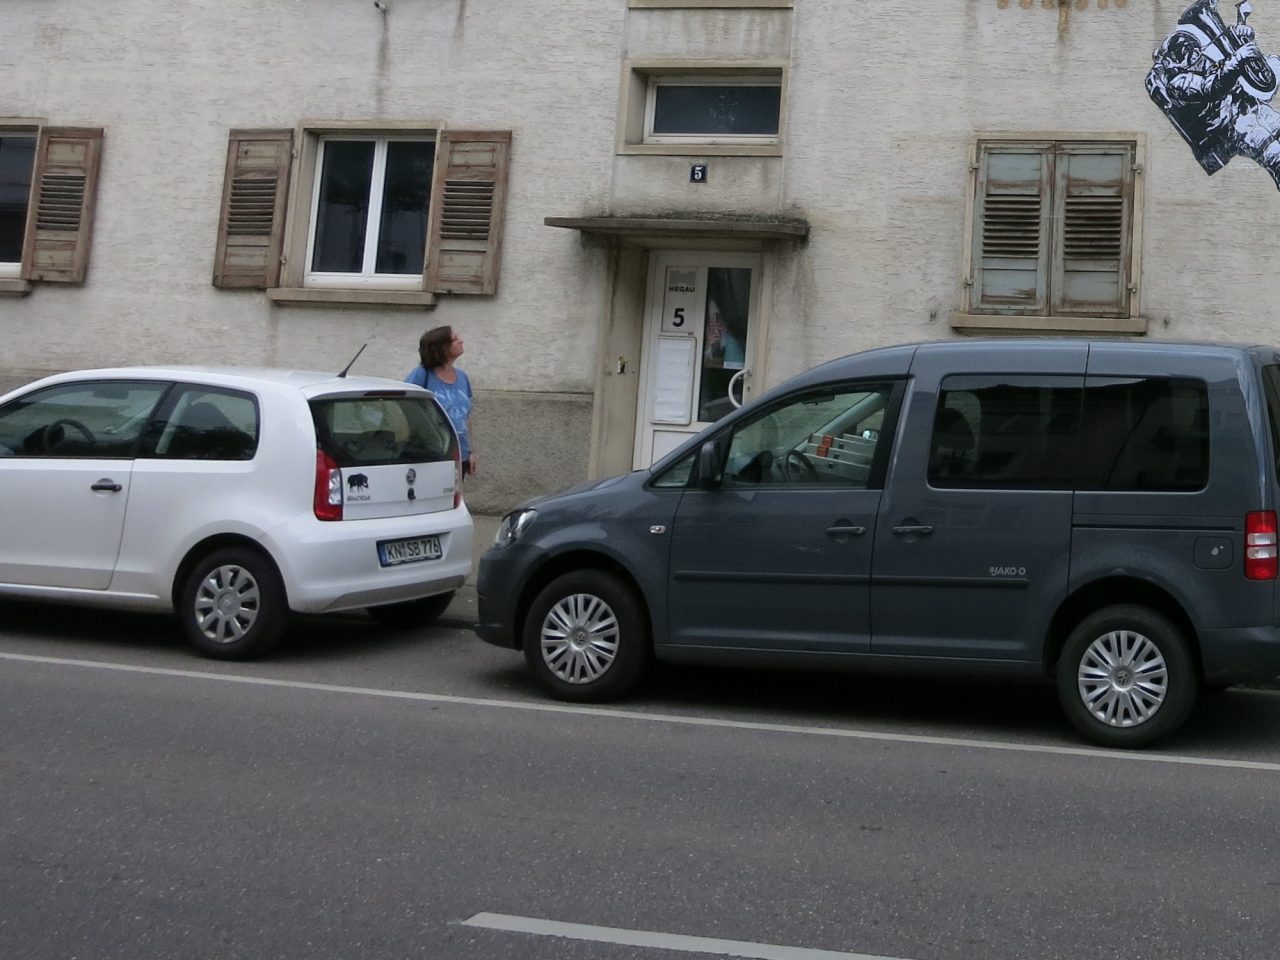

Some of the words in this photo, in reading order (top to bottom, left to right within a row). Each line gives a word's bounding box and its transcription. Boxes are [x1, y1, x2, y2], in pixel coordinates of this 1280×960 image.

[694, 166, 703, 180] 5
[672, 308, 685, 328] 5
[386, 543, 402, 559] KN
[407, 542, 420, 557] SB
[421, 538, 439, 554] 776
[991, 566, 1026, 576] JAKO-O
